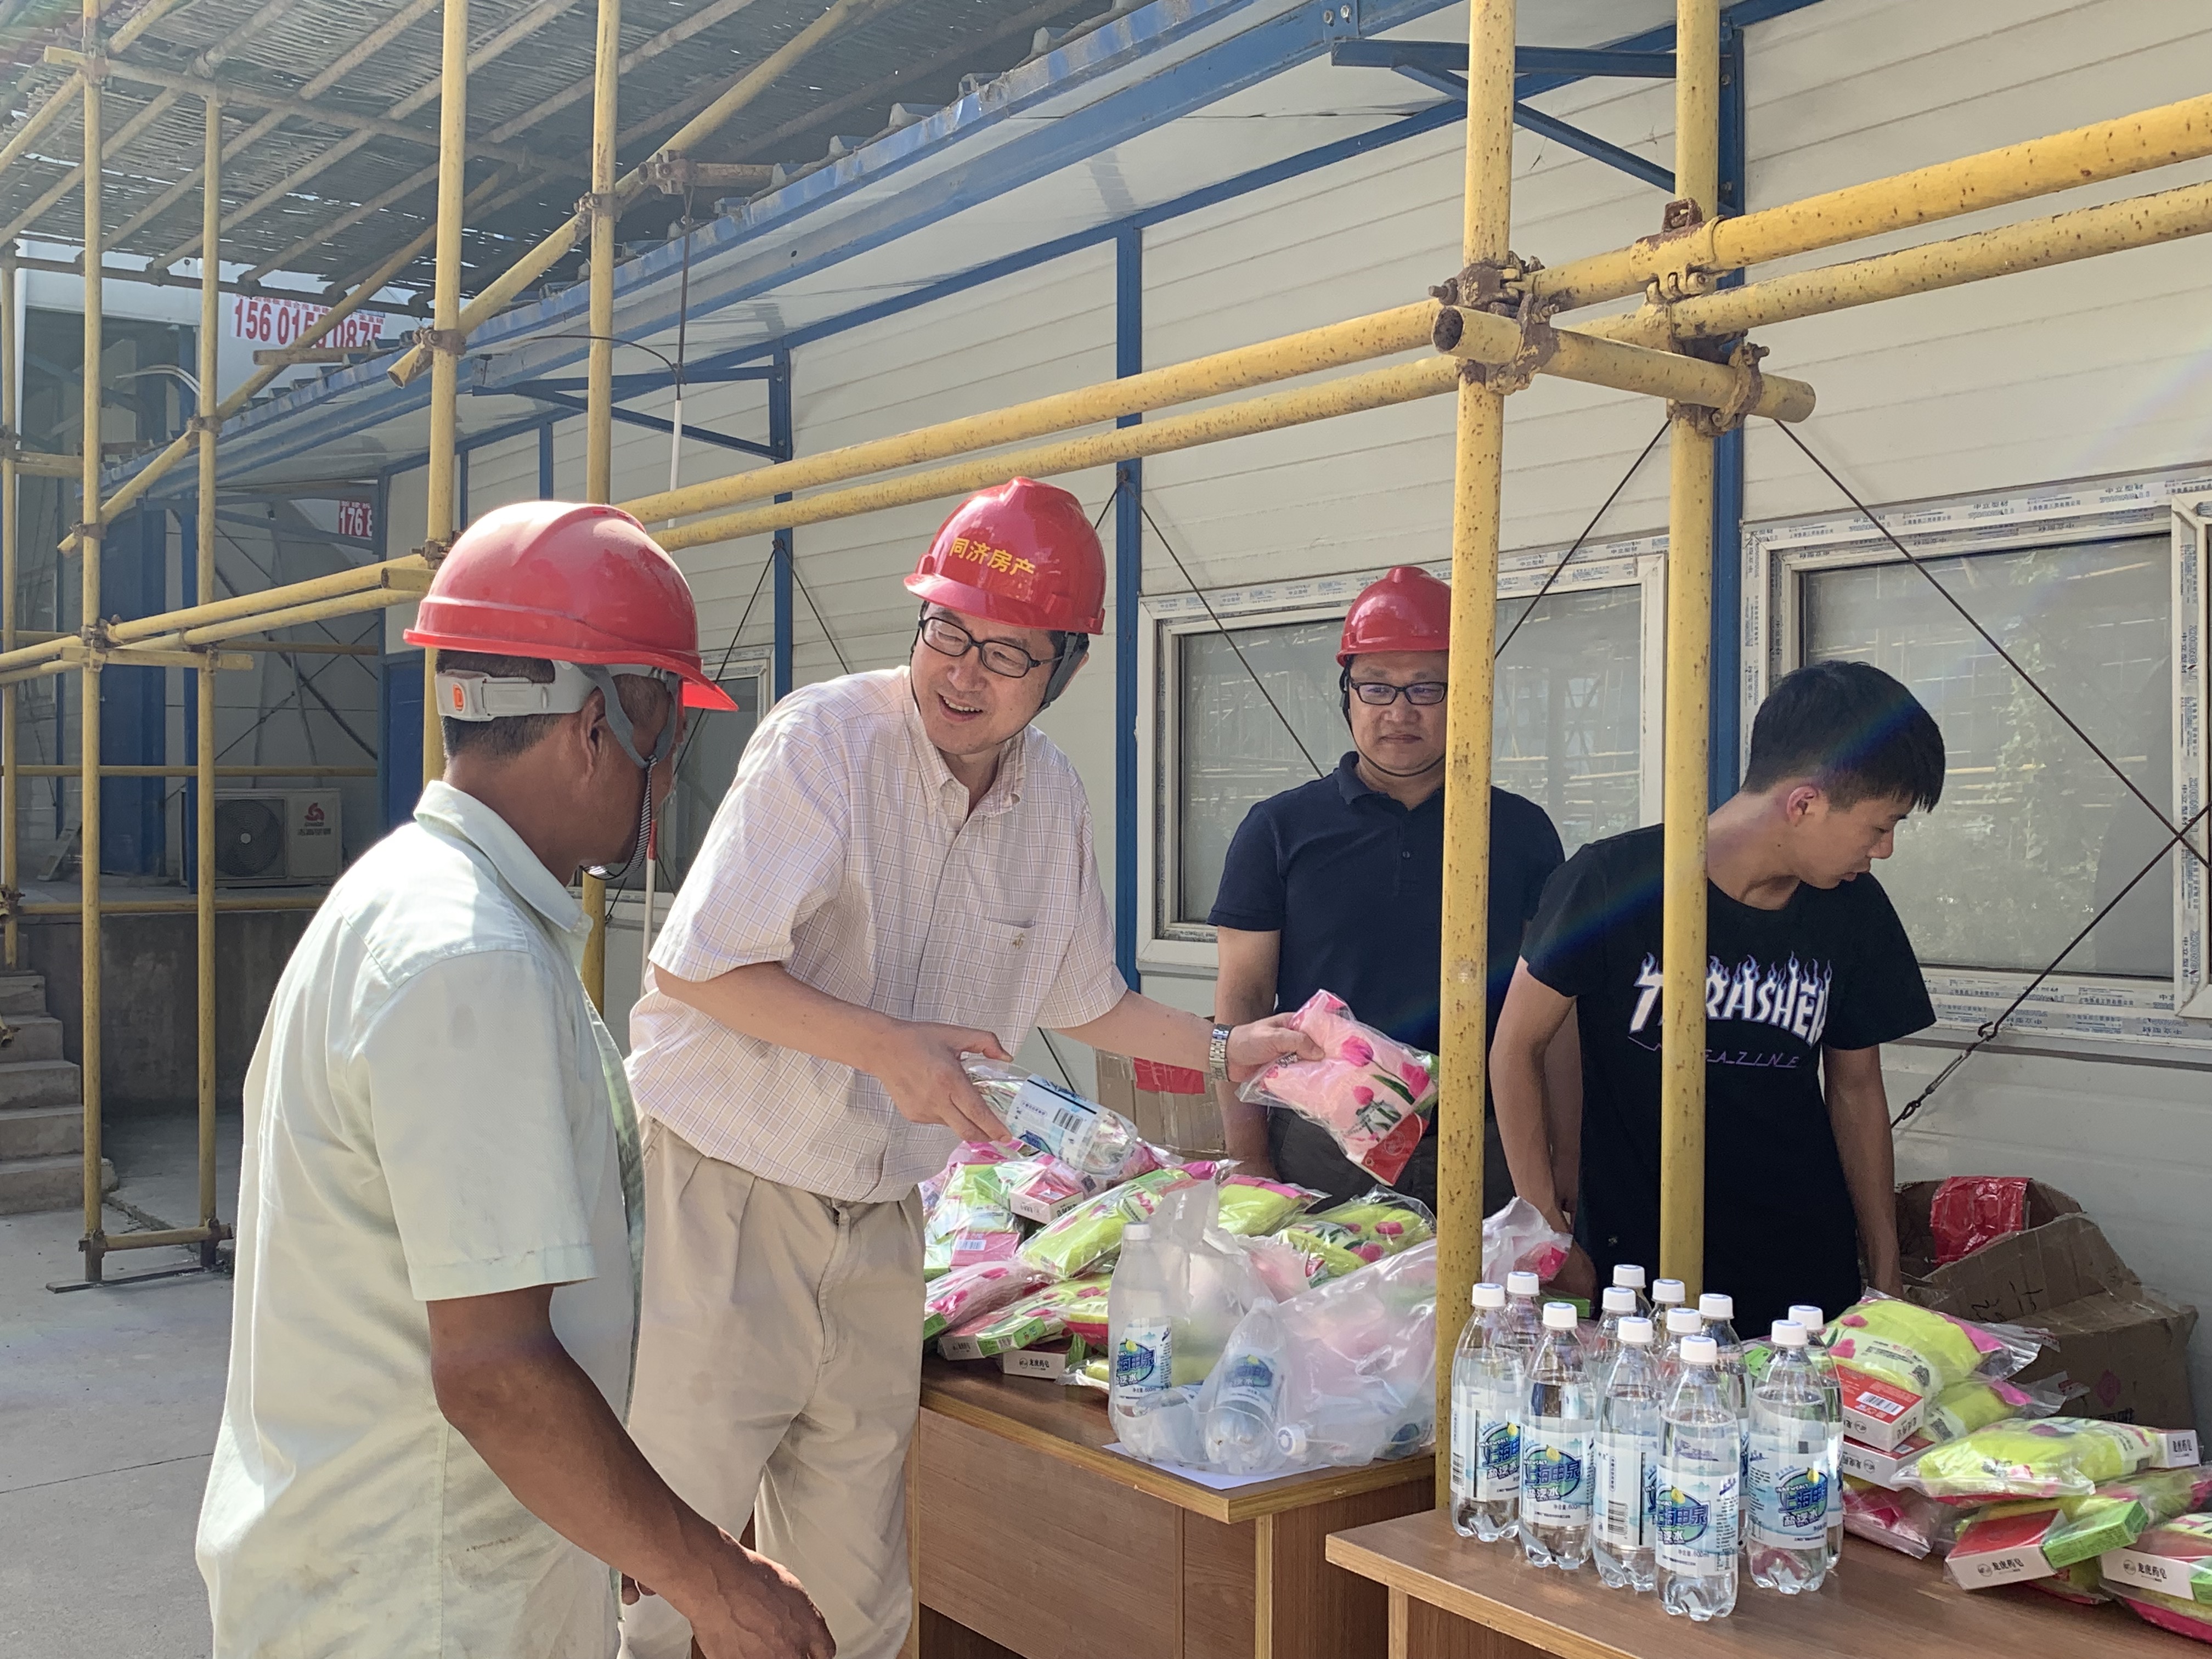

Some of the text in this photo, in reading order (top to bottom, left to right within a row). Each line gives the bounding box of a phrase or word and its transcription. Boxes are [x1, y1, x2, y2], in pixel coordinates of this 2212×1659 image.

[949, 537, 1036, 575] 同济房产
[1629, 951, 1832, 1049] TRASHER
[1525, 1459, 1582, 1486] 上海申泉
